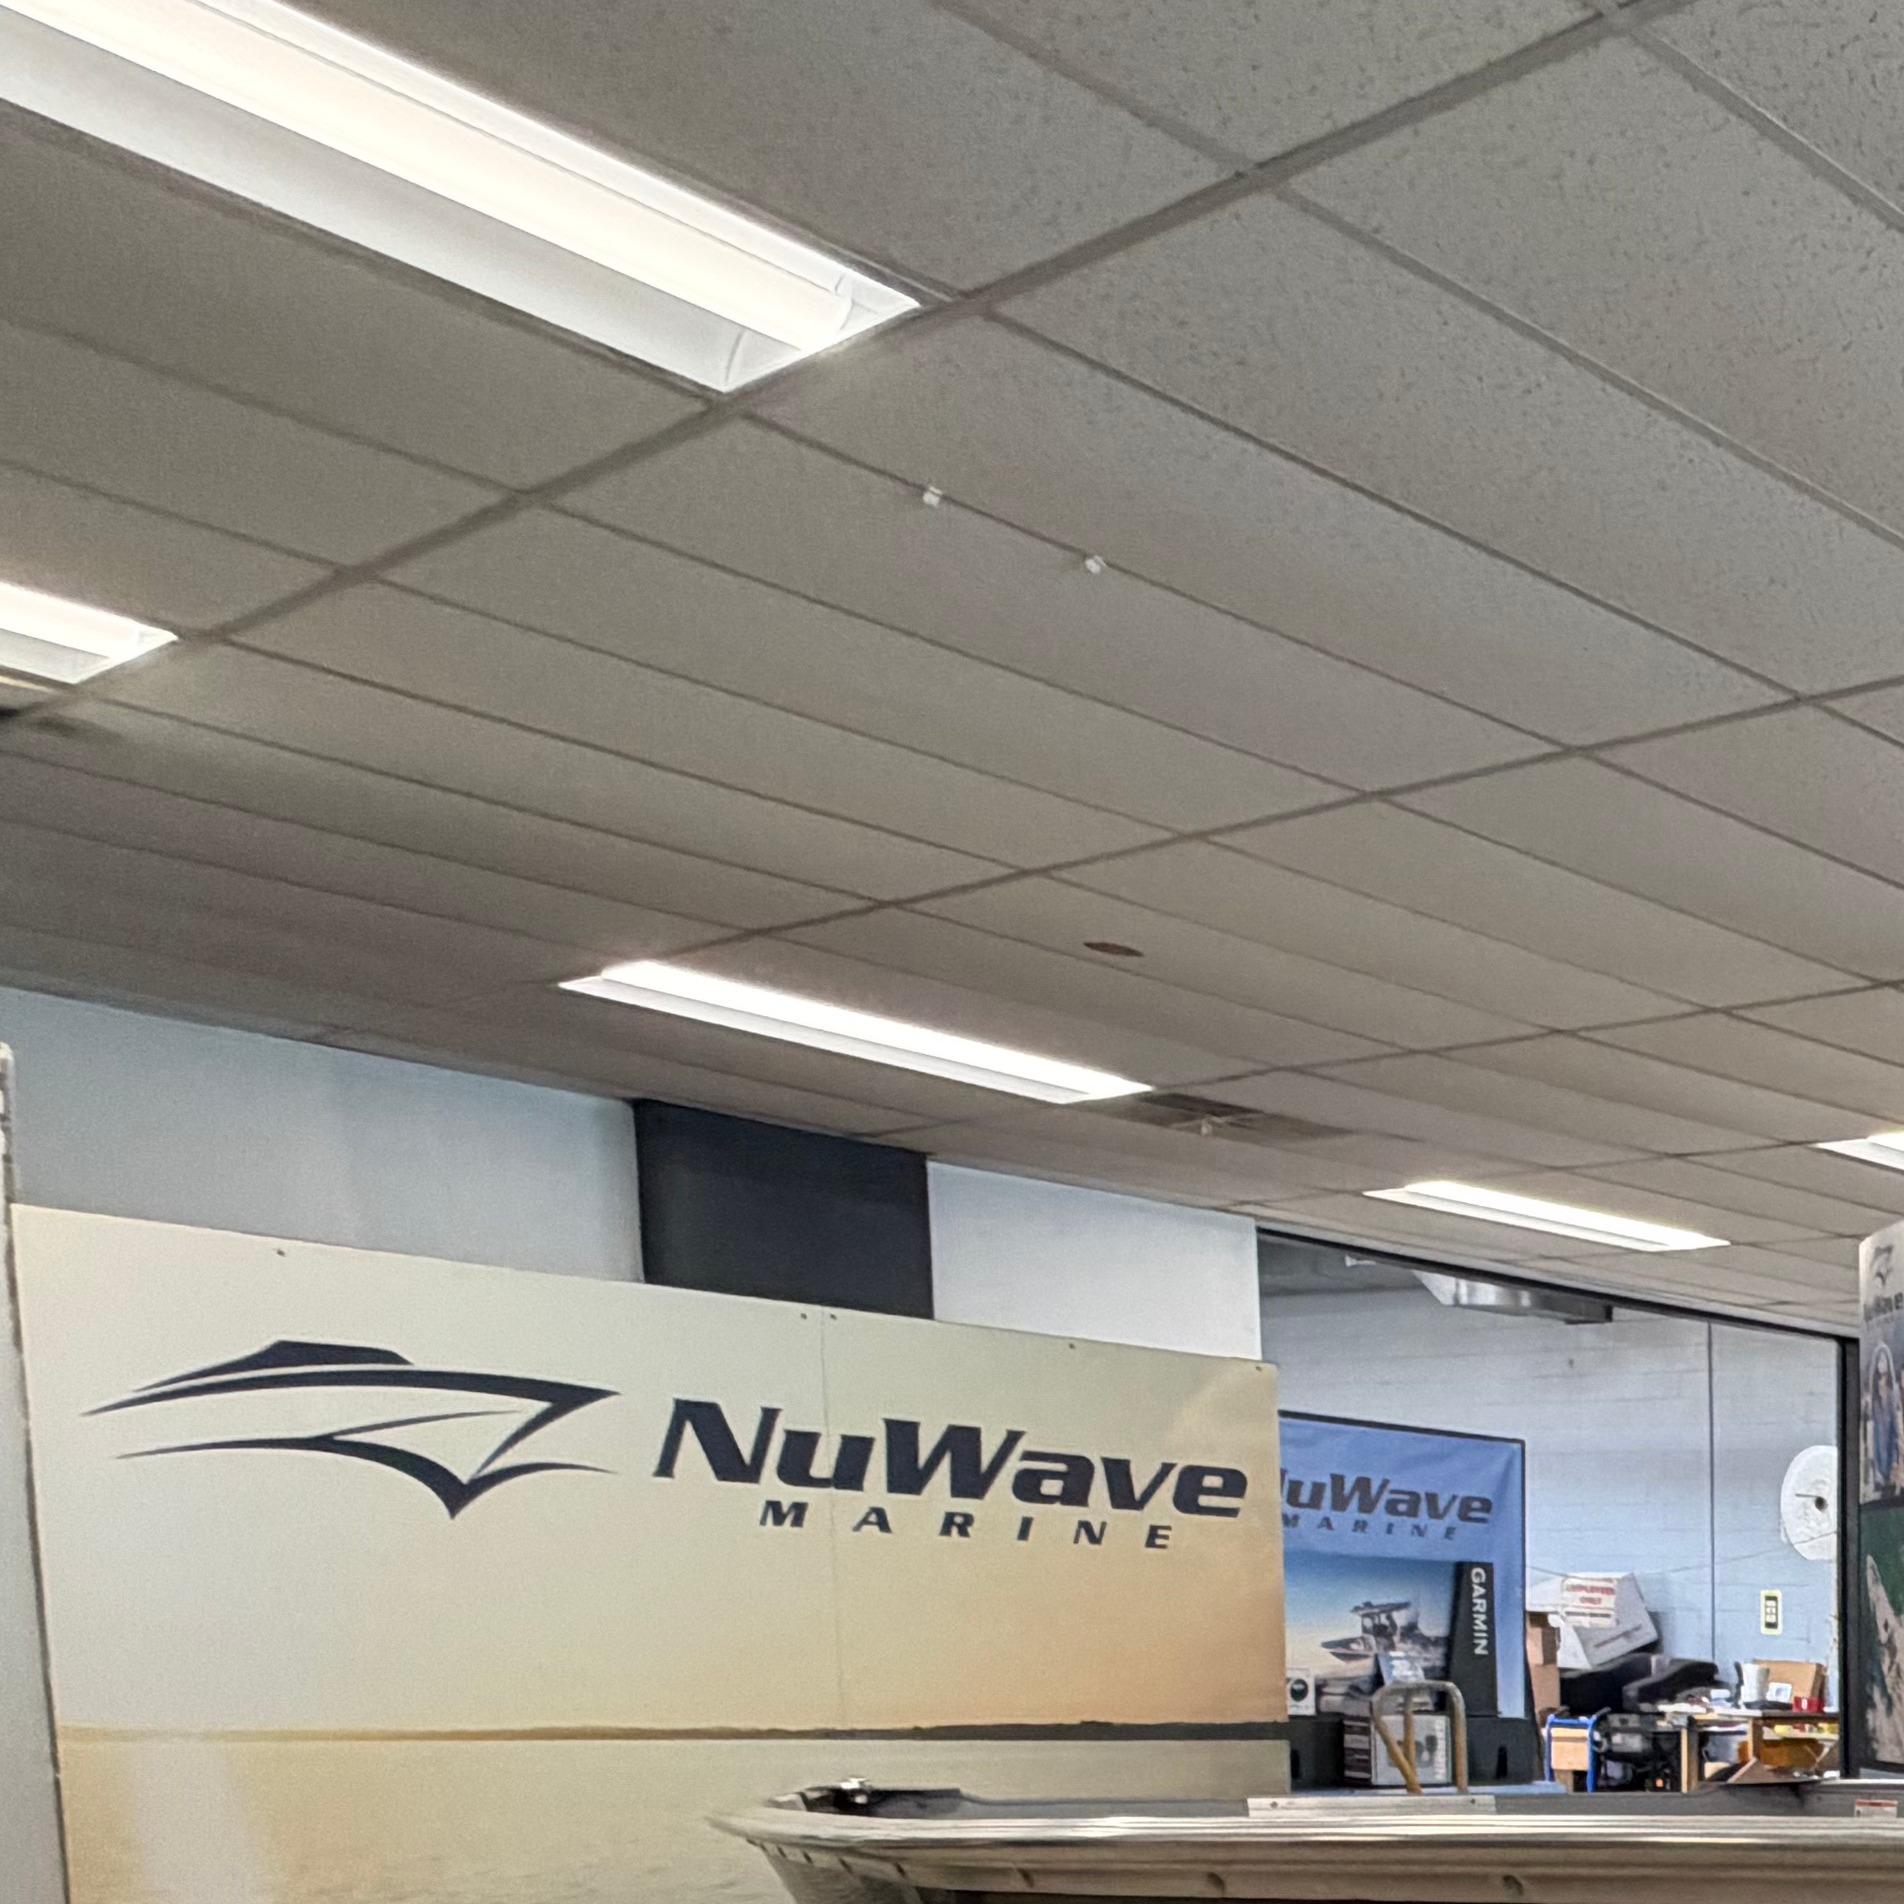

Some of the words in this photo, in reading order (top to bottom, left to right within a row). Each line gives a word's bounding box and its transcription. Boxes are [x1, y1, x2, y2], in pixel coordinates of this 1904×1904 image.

[652, 1397, 1249, 1518] NuWave
[758, 1499, 1173, 1549] MARINE
[1281, 1512, 1457, 1541] MARINE
[1471, 1567, 1489, 1656] GARMIN
